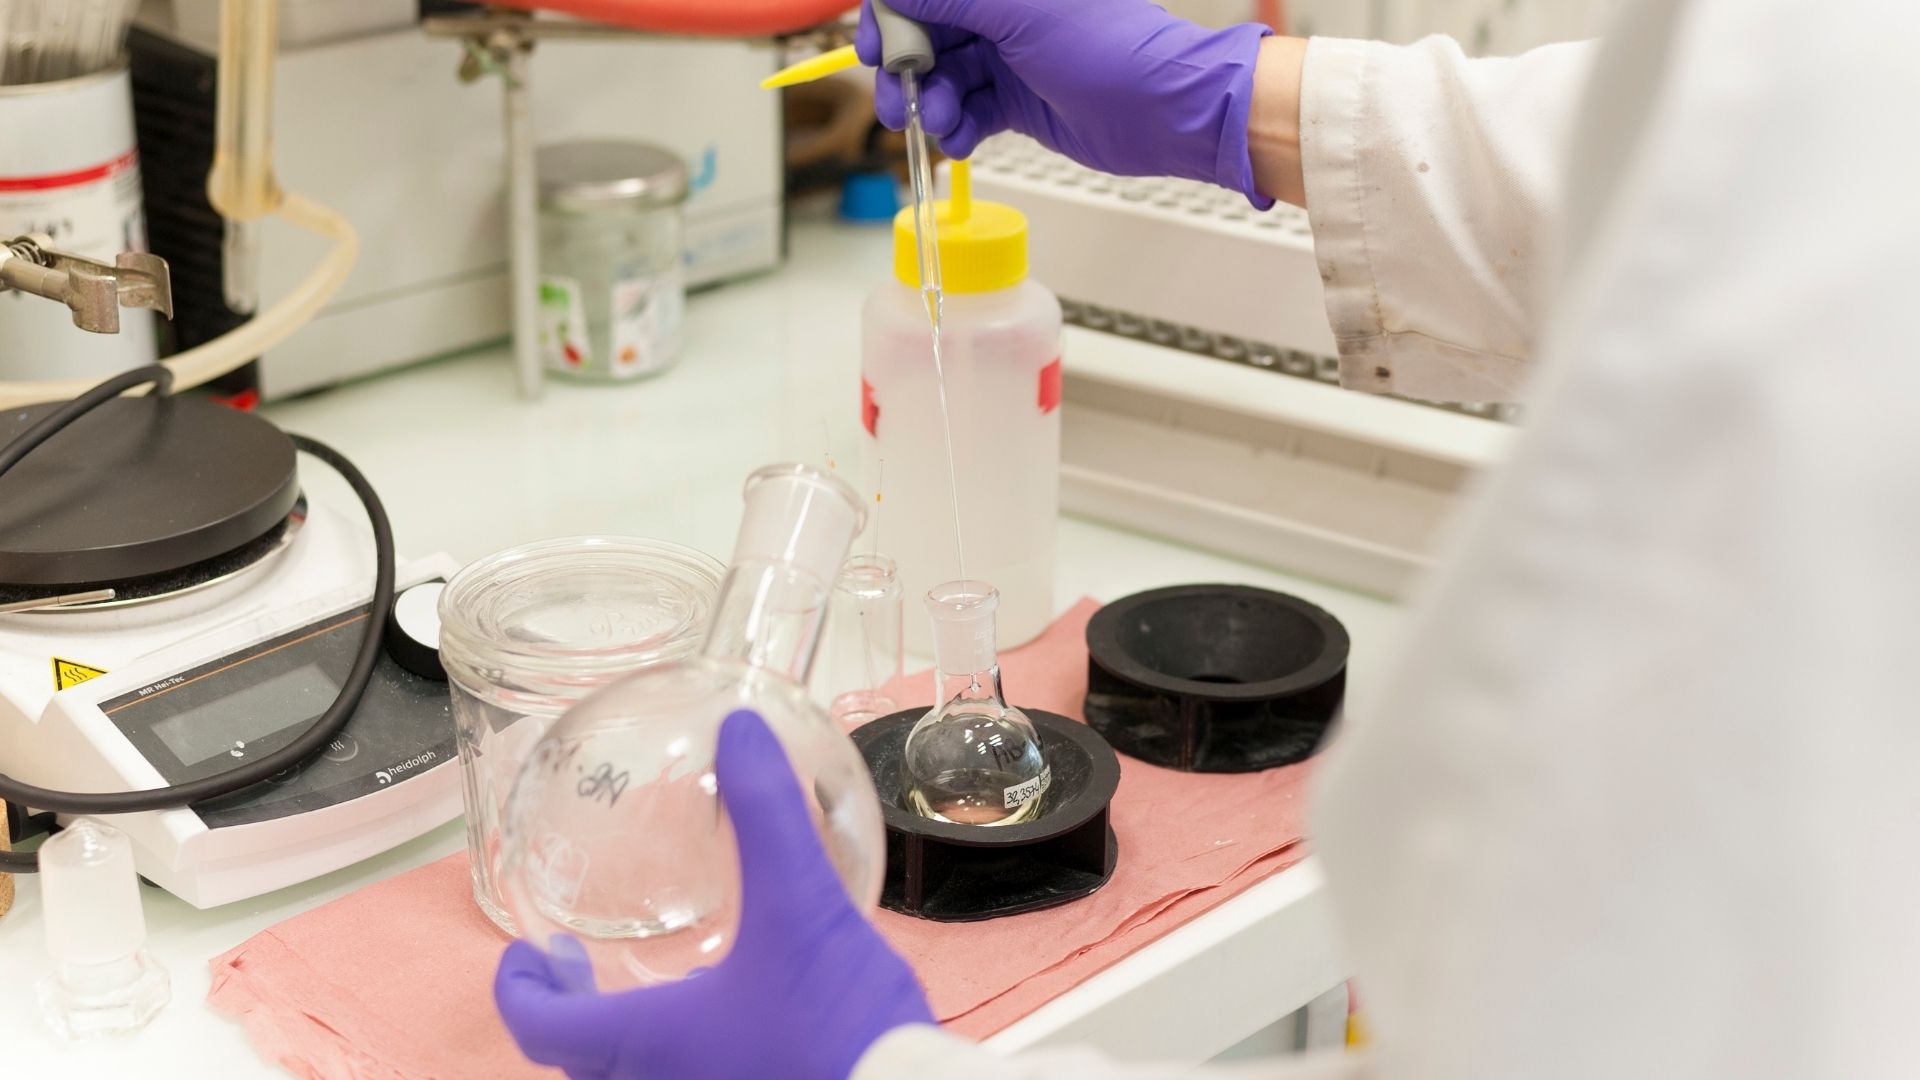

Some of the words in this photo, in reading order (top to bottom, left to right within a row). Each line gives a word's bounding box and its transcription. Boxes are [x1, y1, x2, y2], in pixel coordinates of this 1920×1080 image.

[138, 686, 155, 697] MR
[154, 675, 185, 691] Hei-Tec
[387, 750, 437, 777] heidolph
